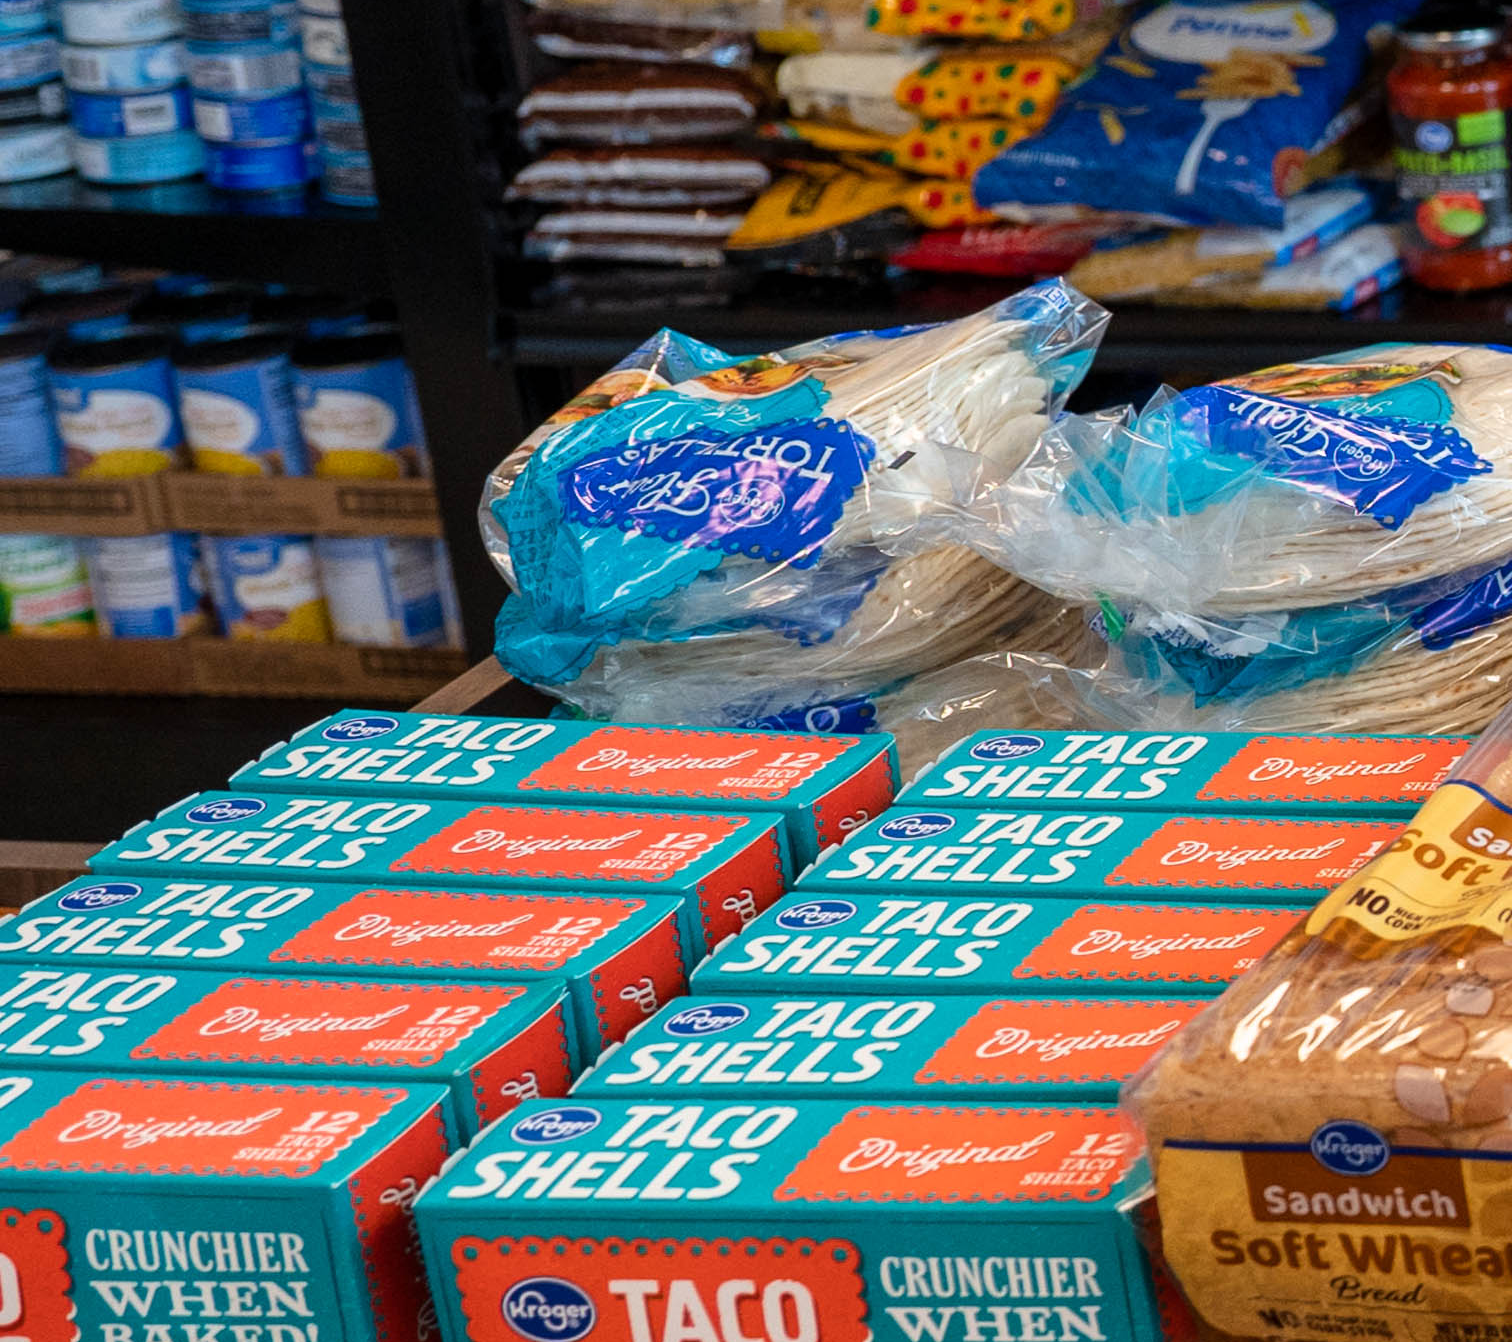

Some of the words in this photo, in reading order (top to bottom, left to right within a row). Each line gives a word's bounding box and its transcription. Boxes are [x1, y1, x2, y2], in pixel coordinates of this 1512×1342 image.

[329, 719, 398, 738] Kroger
[395, 718, 555, 751] TACO
[1049, 735, 1208, 765] TACO
[259, 747, 517, 785] SHELLS
[576, 748, 759, 778] Original
[1248, 755, 1414, 784] Original
[922, 765, 1183, 799] SHELLS
[261, 800, 431, 833] TACO
[119, 828, 389, 867] SHELLS
[451, 830, 628, 858] Original
[648, 832, 709, 850] 12
[636, 848, 686, 860] TACO
[599, 858, 671, 872] SHELLS
[519, 1111, 599, 1140] Kroger
[605, 1105, 799, 1149] TACO
[839, 1133, 1056, 1175] Original
[448, 1152, 760, 1201] SHELLS
[1263, 1185, 1457, 1221] Sandwich
[84, 1228, 310, 1273] CRUNCHIER
[1211, 1229, 1330, 1270] Soft
[880, 1256, 1103, 1299] CRUNCHIER
[89, 1280, 314, 1317] WHEN
[509, 1292, 594, 1333] Kroger
[884, 1306, 1107, 1342] WHEN
